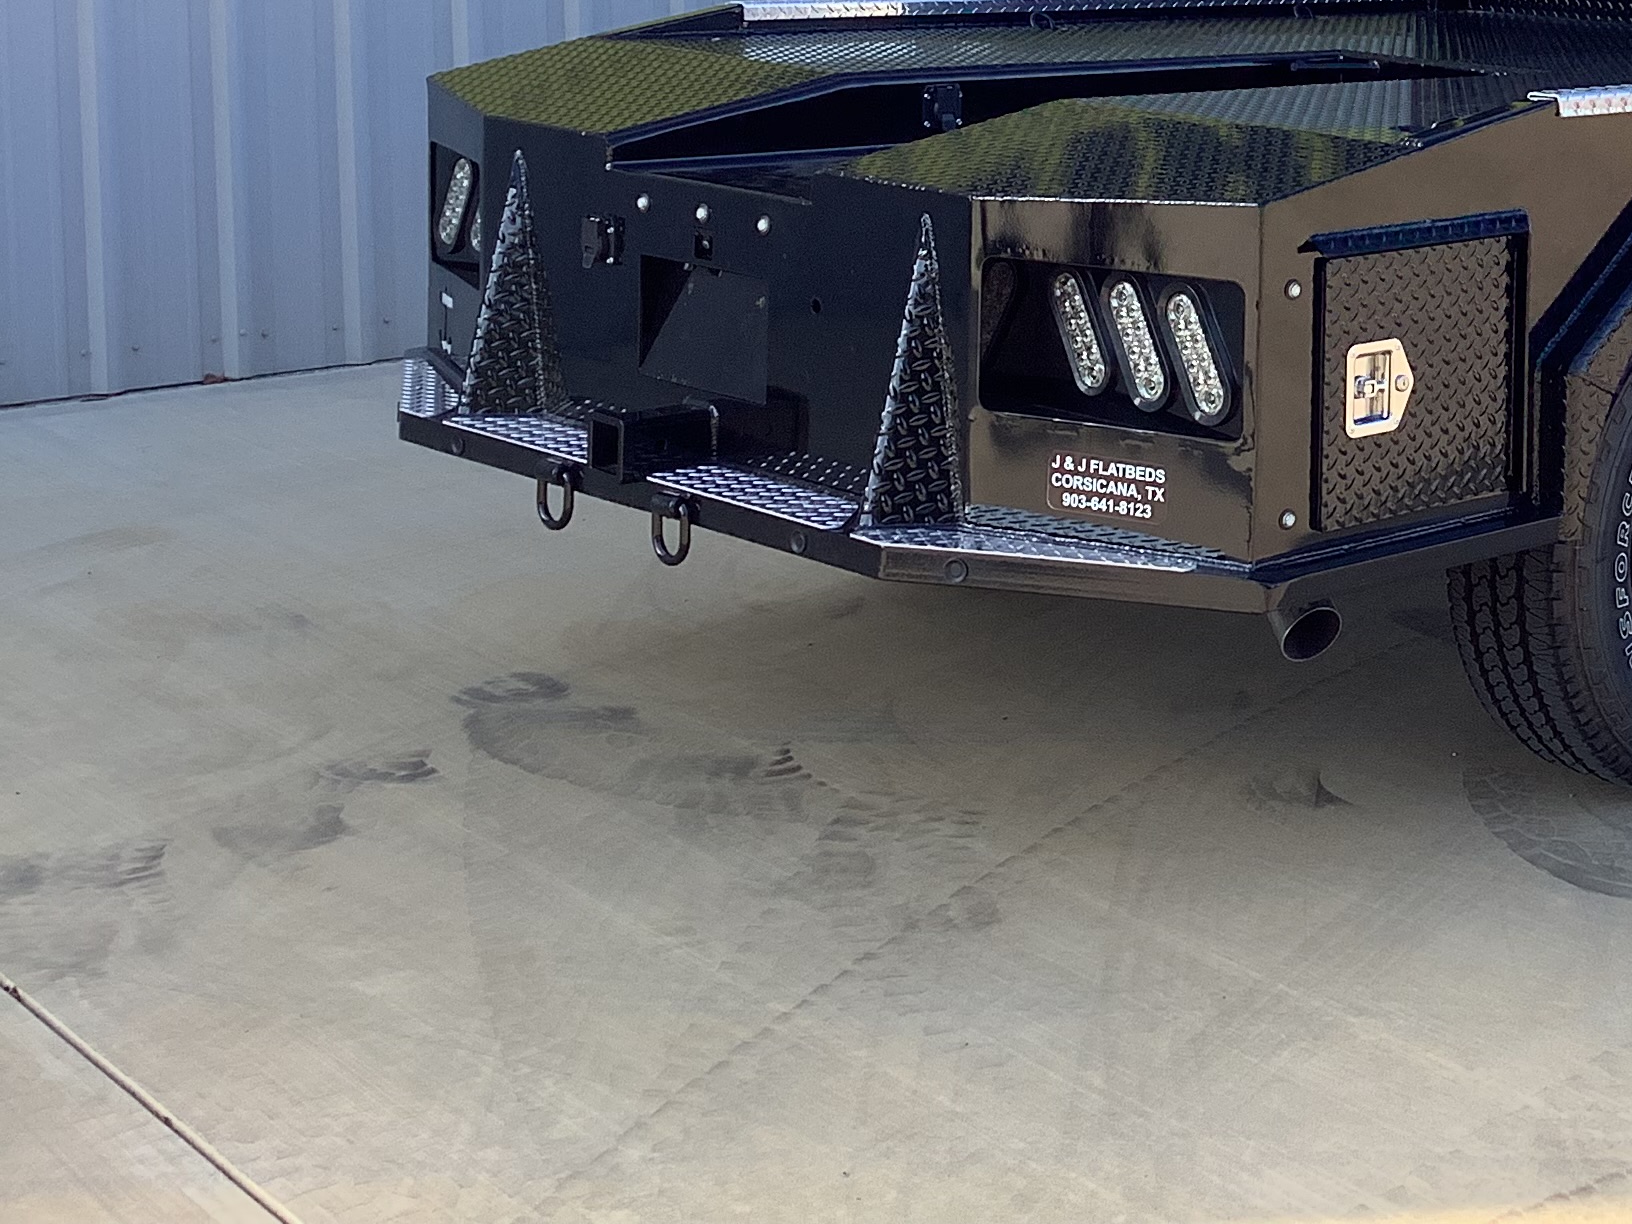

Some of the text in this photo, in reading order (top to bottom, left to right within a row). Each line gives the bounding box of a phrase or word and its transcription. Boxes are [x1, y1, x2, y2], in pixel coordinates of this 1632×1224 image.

[1051, 454, 1166, 484] J & J FLATBEDS
[1051, 472, 1166, 503] CORSICANA, TX
[1061, 492, 1152, 519] 903-641-8123
